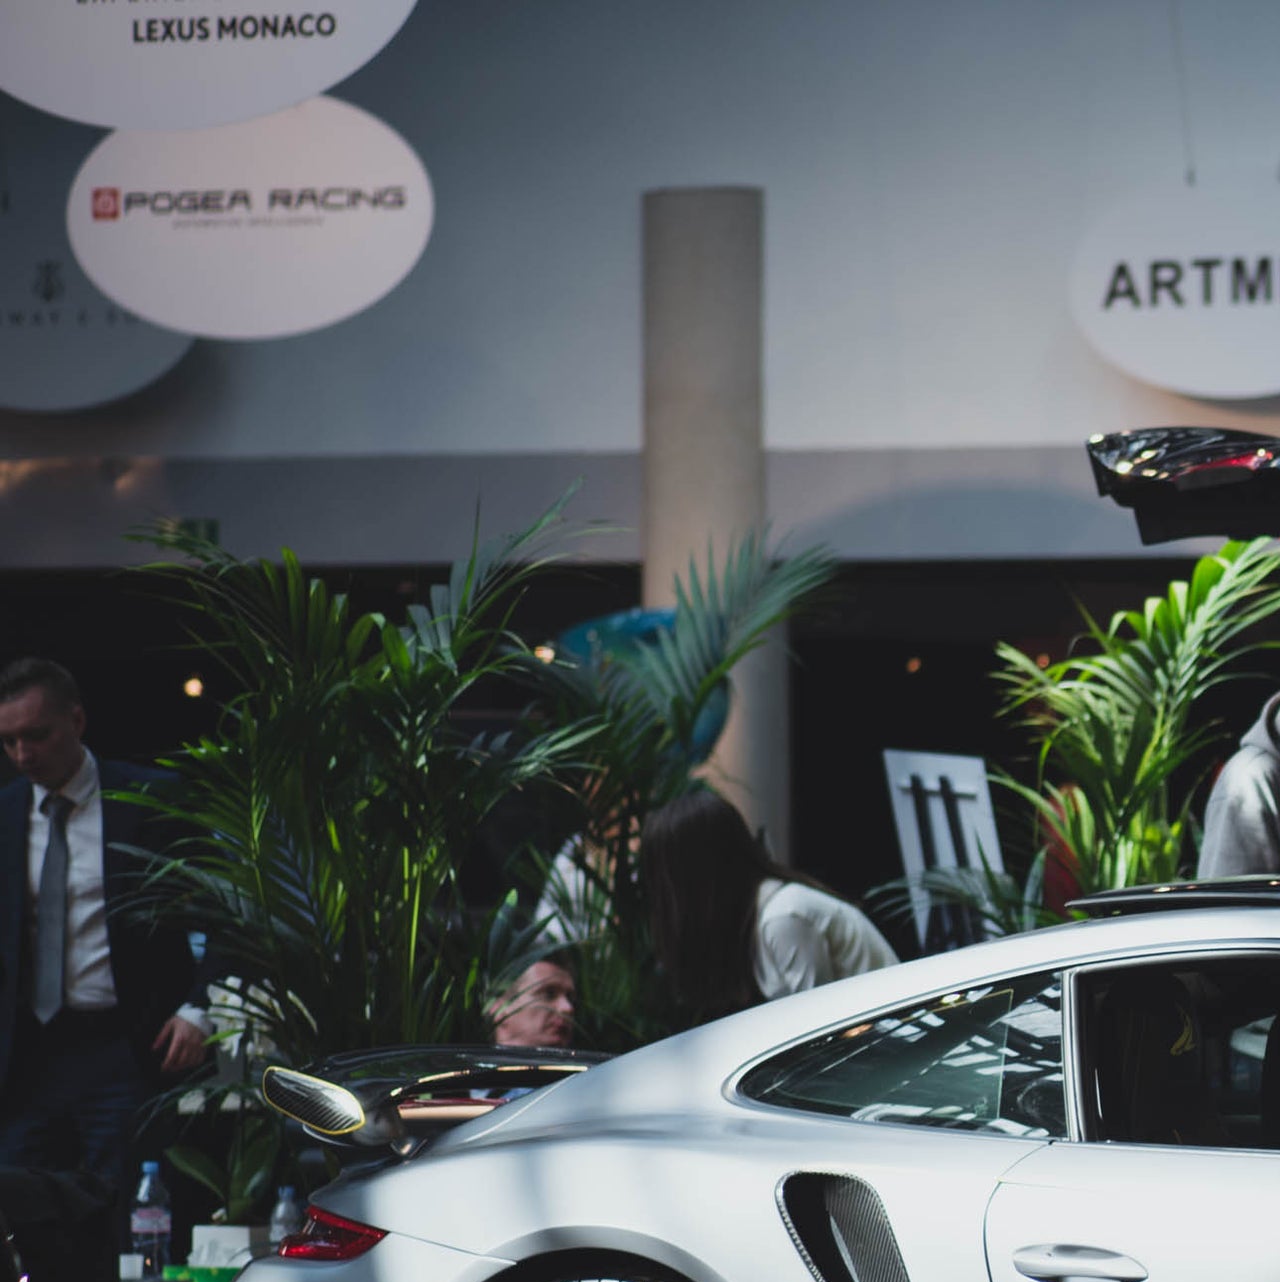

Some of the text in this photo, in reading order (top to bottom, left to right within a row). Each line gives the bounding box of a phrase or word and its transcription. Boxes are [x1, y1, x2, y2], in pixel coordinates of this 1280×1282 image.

[132, 13, 337, 43] LEXUS MONACO
[122, 186, 406, 214] POGEA RACING
